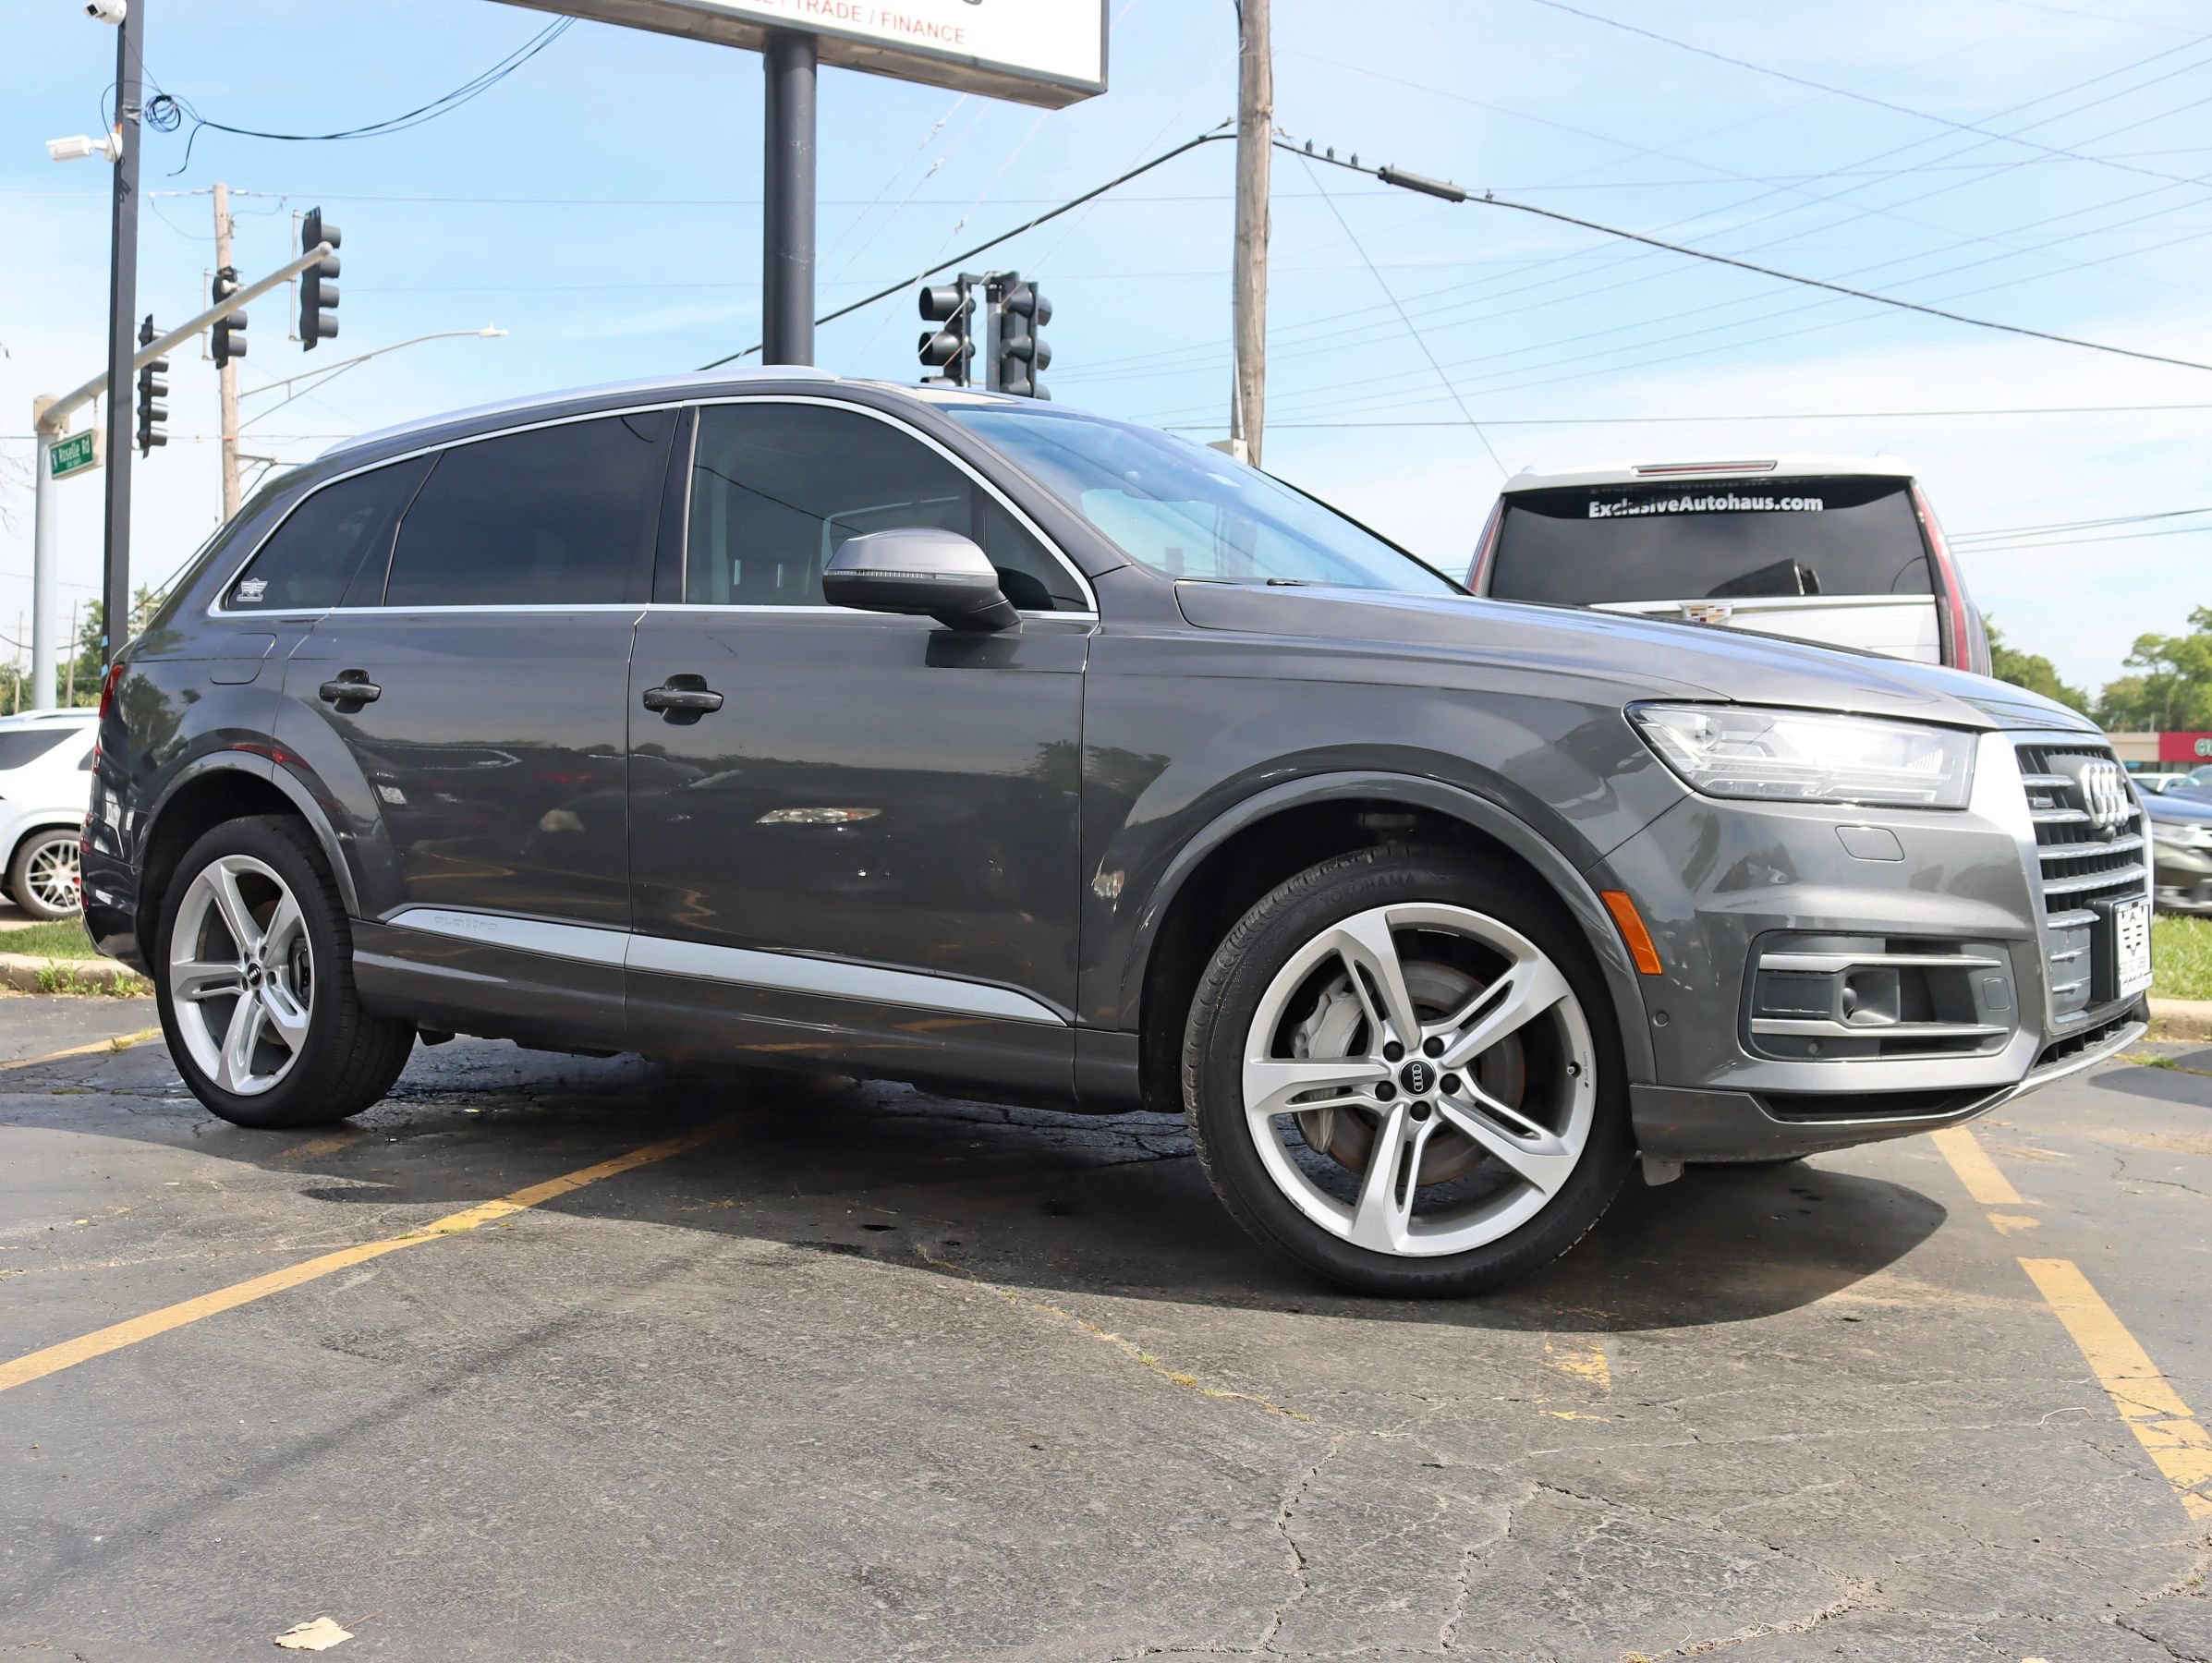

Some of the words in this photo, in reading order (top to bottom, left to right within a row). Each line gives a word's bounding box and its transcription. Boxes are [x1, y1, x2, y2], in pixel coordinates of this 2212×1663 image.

[881, 12, 966, 44] FINANCE
[58, 442, 80, 463] Roselle
[81, 434, 91, 454] Rd
[1324, 871, 1416, 904] YOKOHAMA
